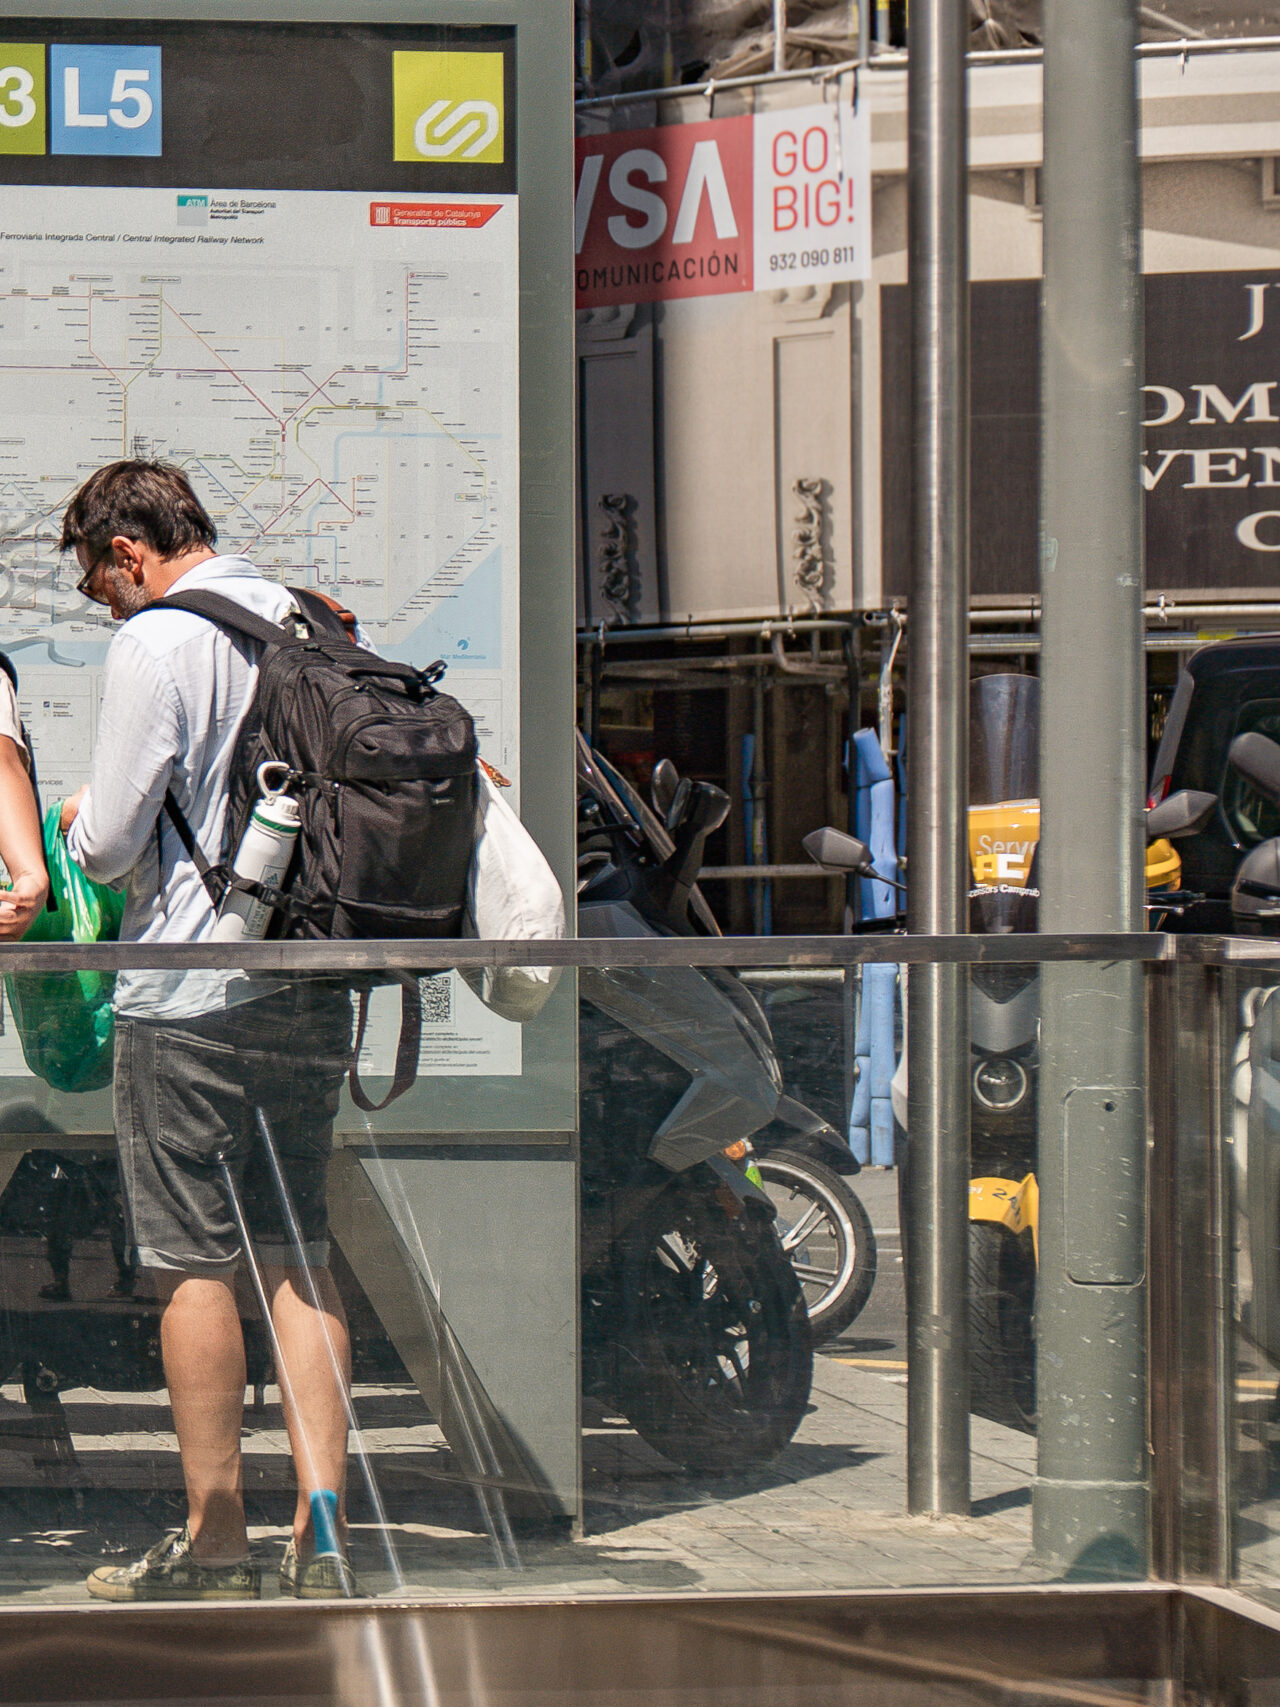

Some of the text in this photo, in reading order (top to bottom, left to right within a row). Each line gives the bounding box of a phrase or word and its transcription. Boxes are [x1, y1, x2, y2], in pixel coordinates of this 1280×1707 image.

[63, 67, 153, 129] L5
[772, 126, 828, 177] GO
[229, 199, 239, 207] de
[240, 199, 277, 208] Barcelona
[773, 177, 854, 232] BIG!
[393, 216, 467, 227] Transports públics
[434, 209, 444, 217] de
[445, 209, 482, 219] Catalunya
[45, 232, 84, 243] Integrada
[85, 233, 116, 242] Central
[122, 233, 152, 243] Central
[154, 234, 196, 244] Integrated
[197, 235, 229, 245] Railway
[230, 236, 265, 245] Network
[770, 246, 854, 271] 932 090 811
[577, 250, 739, 291] OMUNICACIÓN
[967, 883, 1041, 898] censors Camprub
